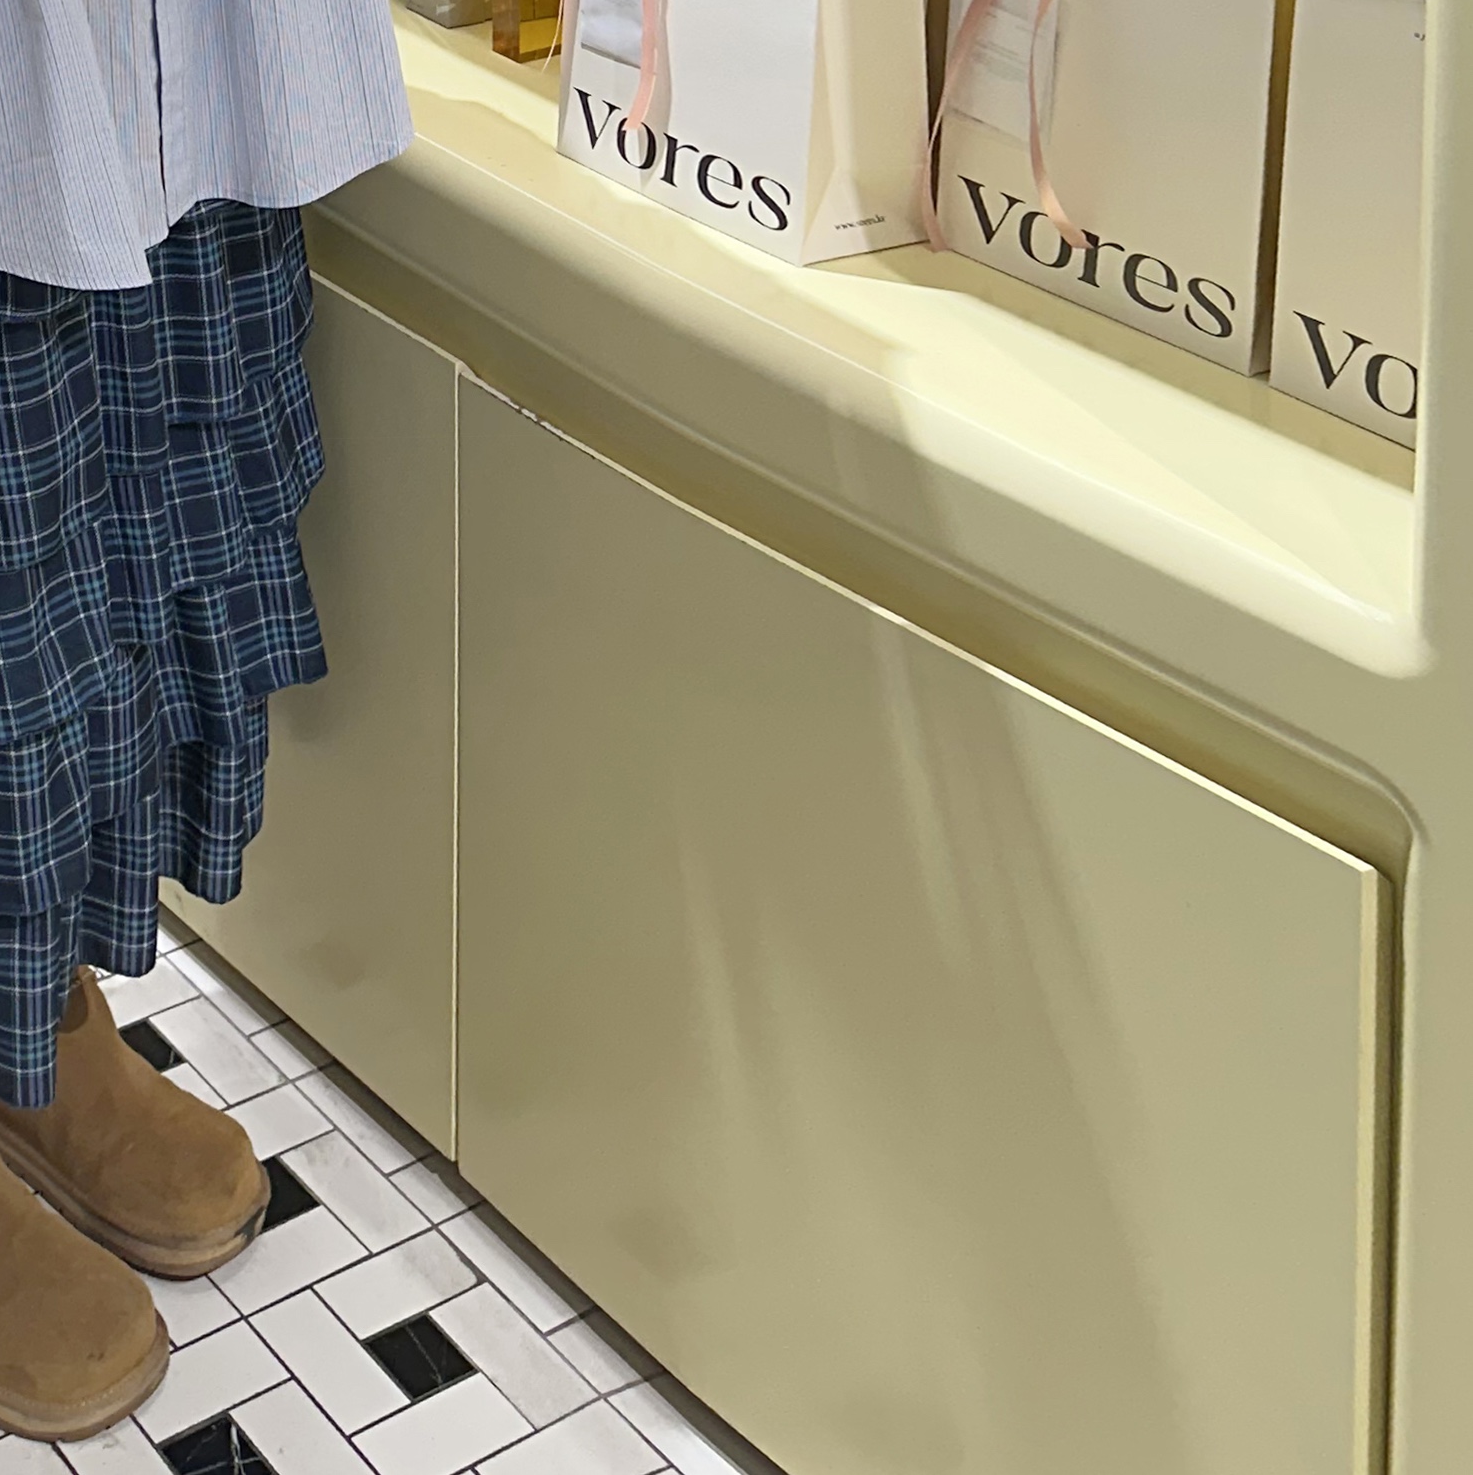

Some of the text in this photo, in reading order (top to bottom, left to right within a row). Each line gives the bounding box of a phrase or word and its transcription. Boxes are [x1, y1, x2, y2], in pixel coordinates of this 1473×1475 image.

[573, 86, 791, 231] vores
[957, 174, 1236, 338] vores
[1292, 310, 1418, 419] vo
